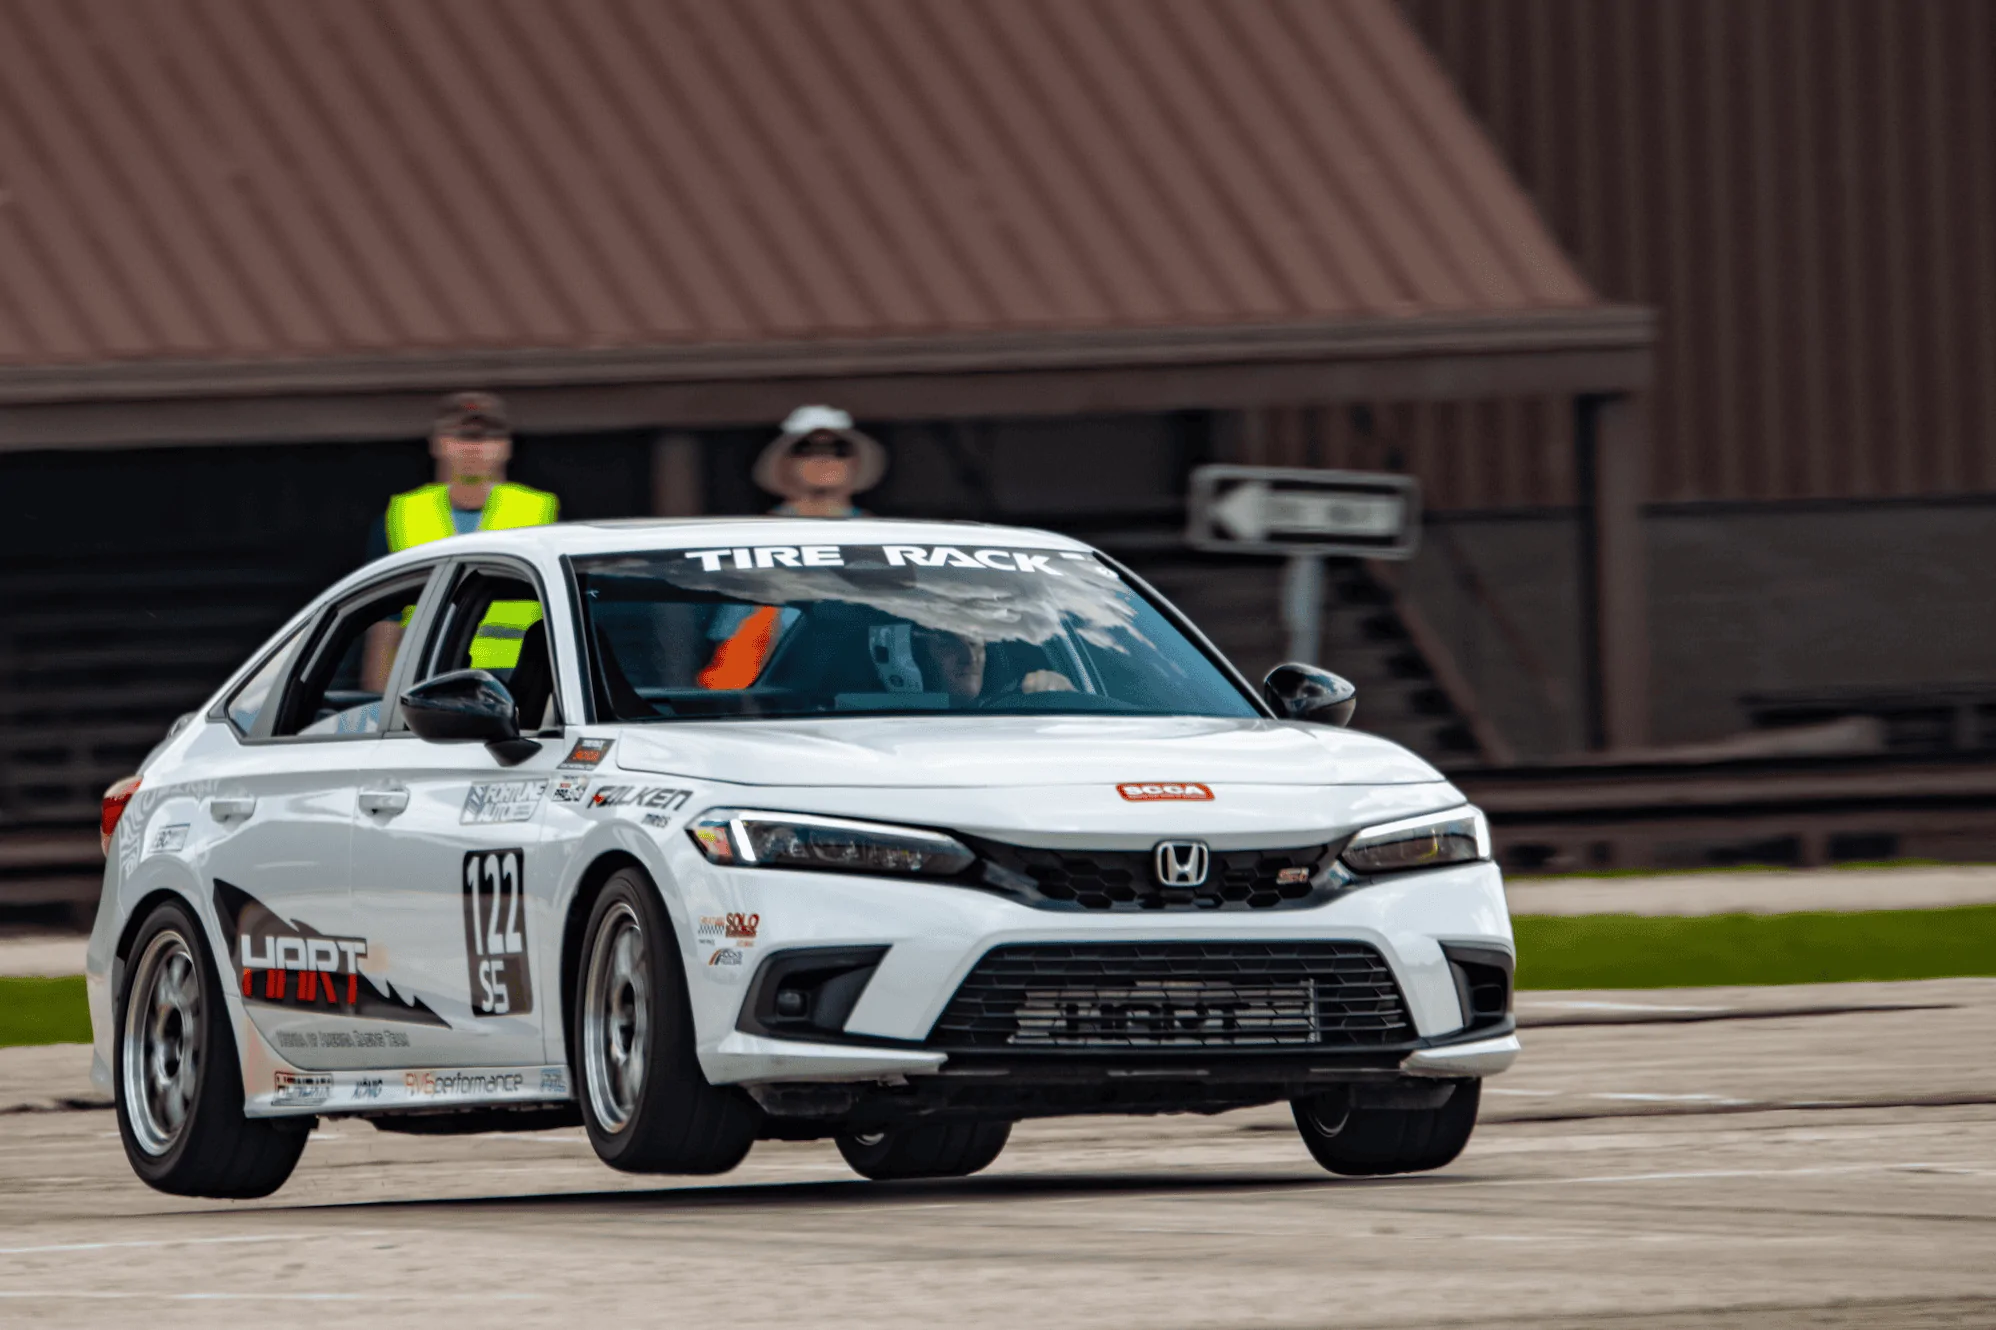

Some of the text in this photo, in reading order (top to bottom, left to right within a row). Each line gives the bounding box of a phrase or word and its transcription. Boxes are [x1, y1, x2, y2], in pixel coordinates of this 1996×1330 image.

[685, 545, 845, 572] TIRE
[882, 545, 1063, 577] RACK
[586, 784, 695, 811] FALKEN
[1123, 785, 1206, 796] SCCA
[467, 852, 523, 956] 122
[241, 934, 367, 1005] HART
